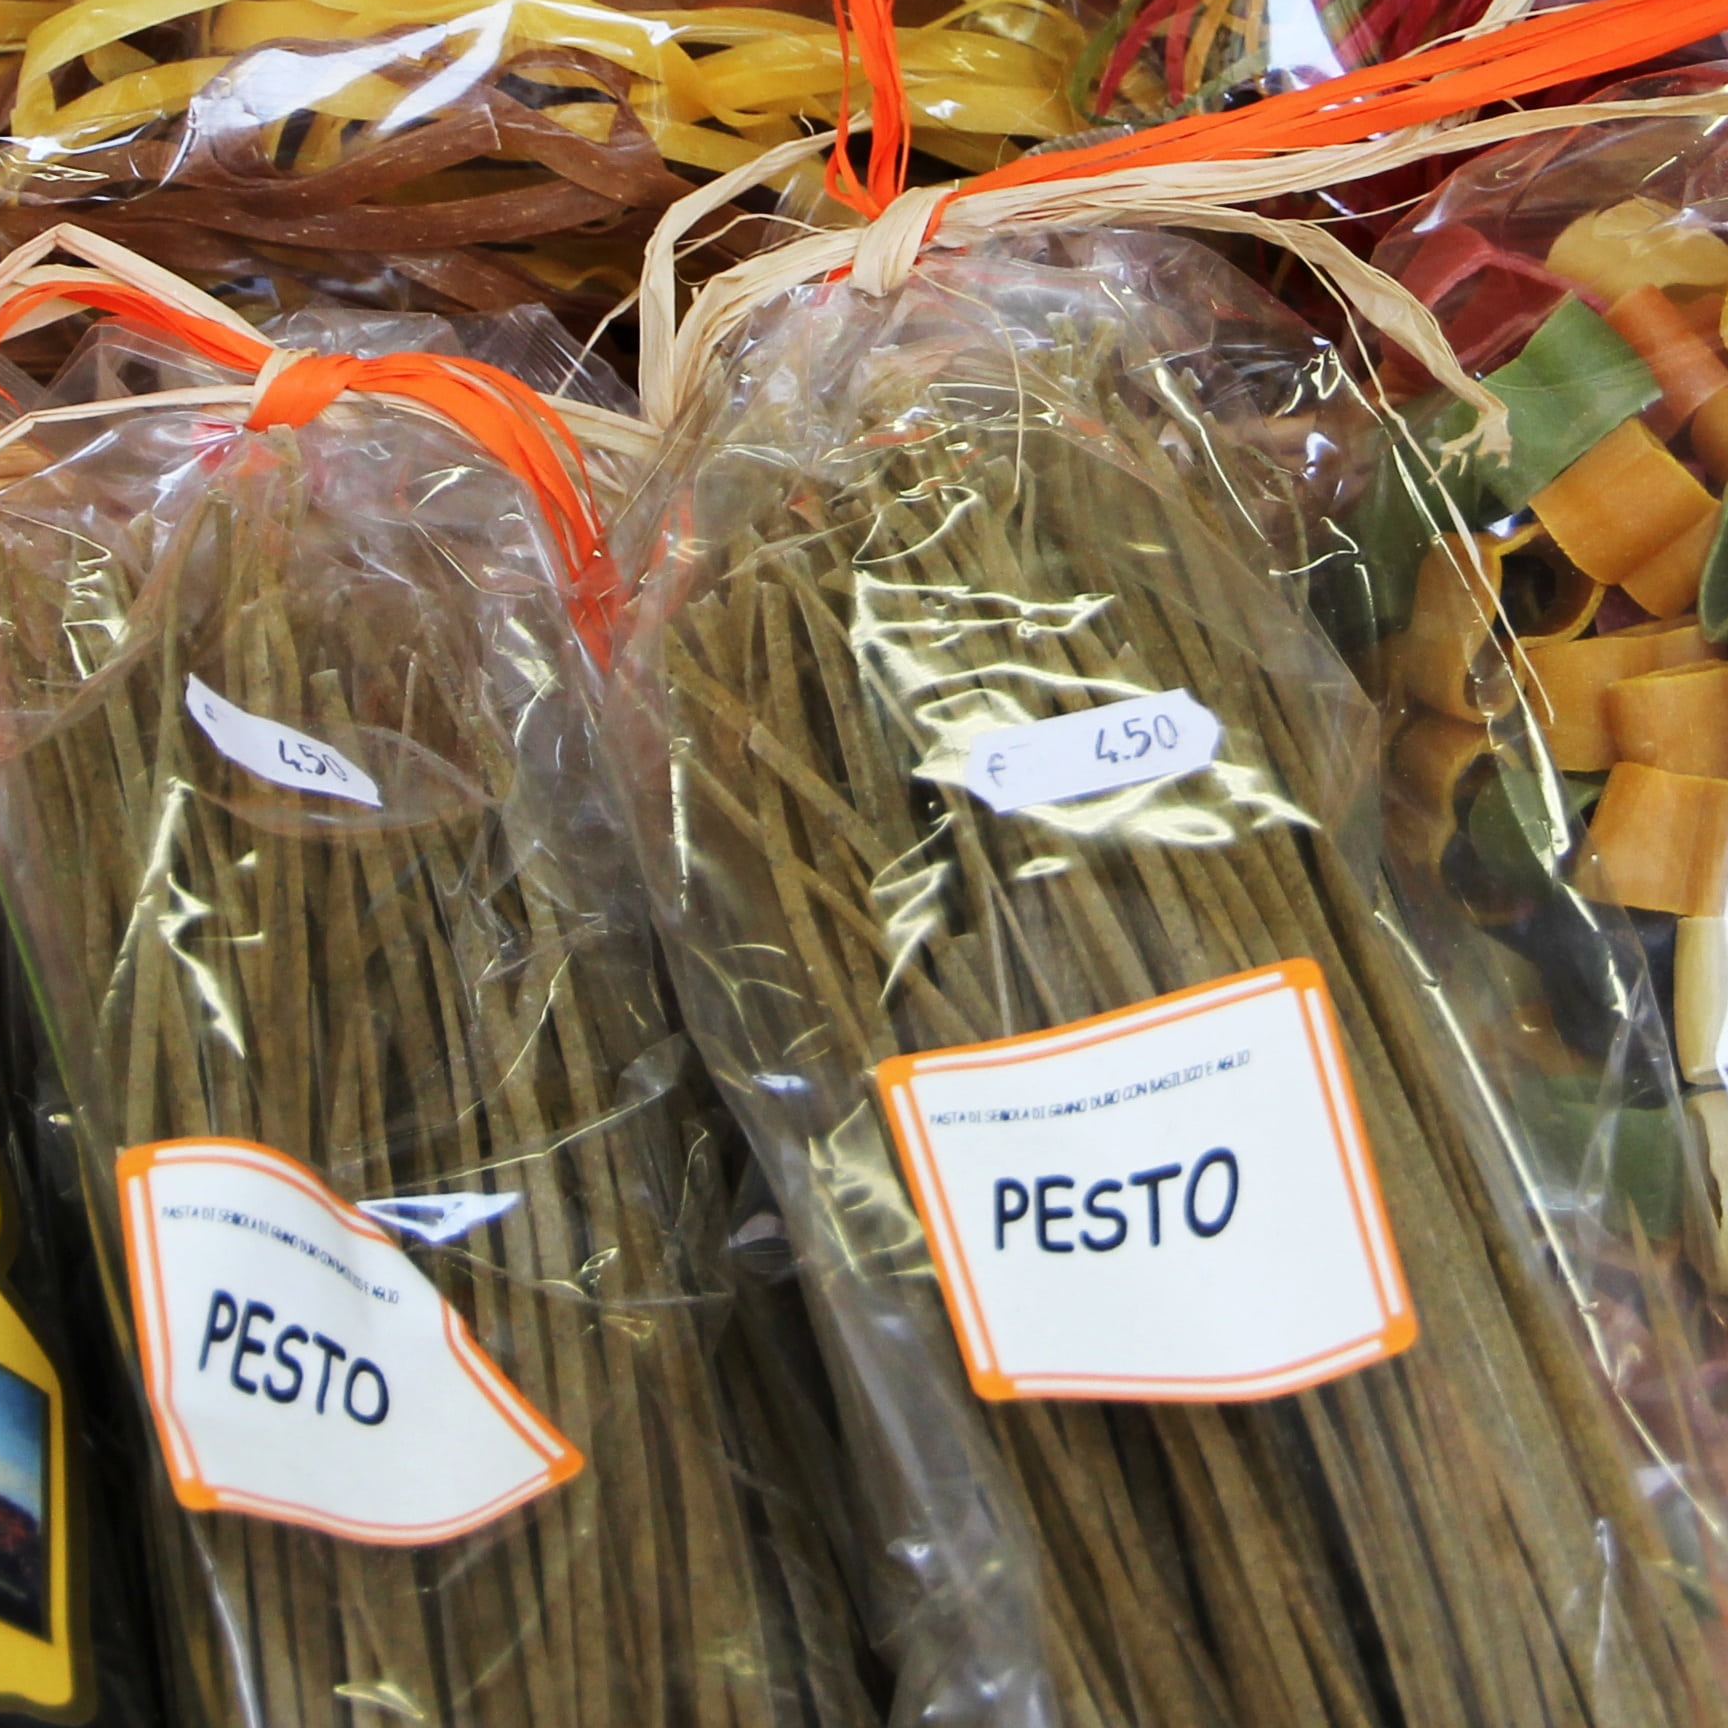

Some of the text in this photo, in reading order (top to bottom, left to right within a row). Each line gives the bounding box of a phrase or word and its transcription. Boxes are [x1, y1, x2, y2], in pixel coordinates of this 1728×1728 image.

[1094, 713, 1179, 764] 4.50
[929, 1112, 966, 1125] PASTA
[969, 1110, 982, 1123] DI
[1032, 1106, 1045, 1120] DI
[1048, 1098, 1088, 1118] GRANO
[1090, 1088, 1121, 1110] DURO
[1122, 1082, 1147, 1101] CON
[1149, 1063, 1204, 1094] BASILICO
[1206, 1060, 1213, 1076] E
[1217, 1049, 1251, 1071] AGLIO
[993, 1146, 1240, 1253] PESTO
[161, 1205, 199, 1219] PASTA
[201, 1207, 215, 1221] DI
[372, 1284, 400, 1305] AGLIO
[198, 1288, 390, 1426] PESTO
